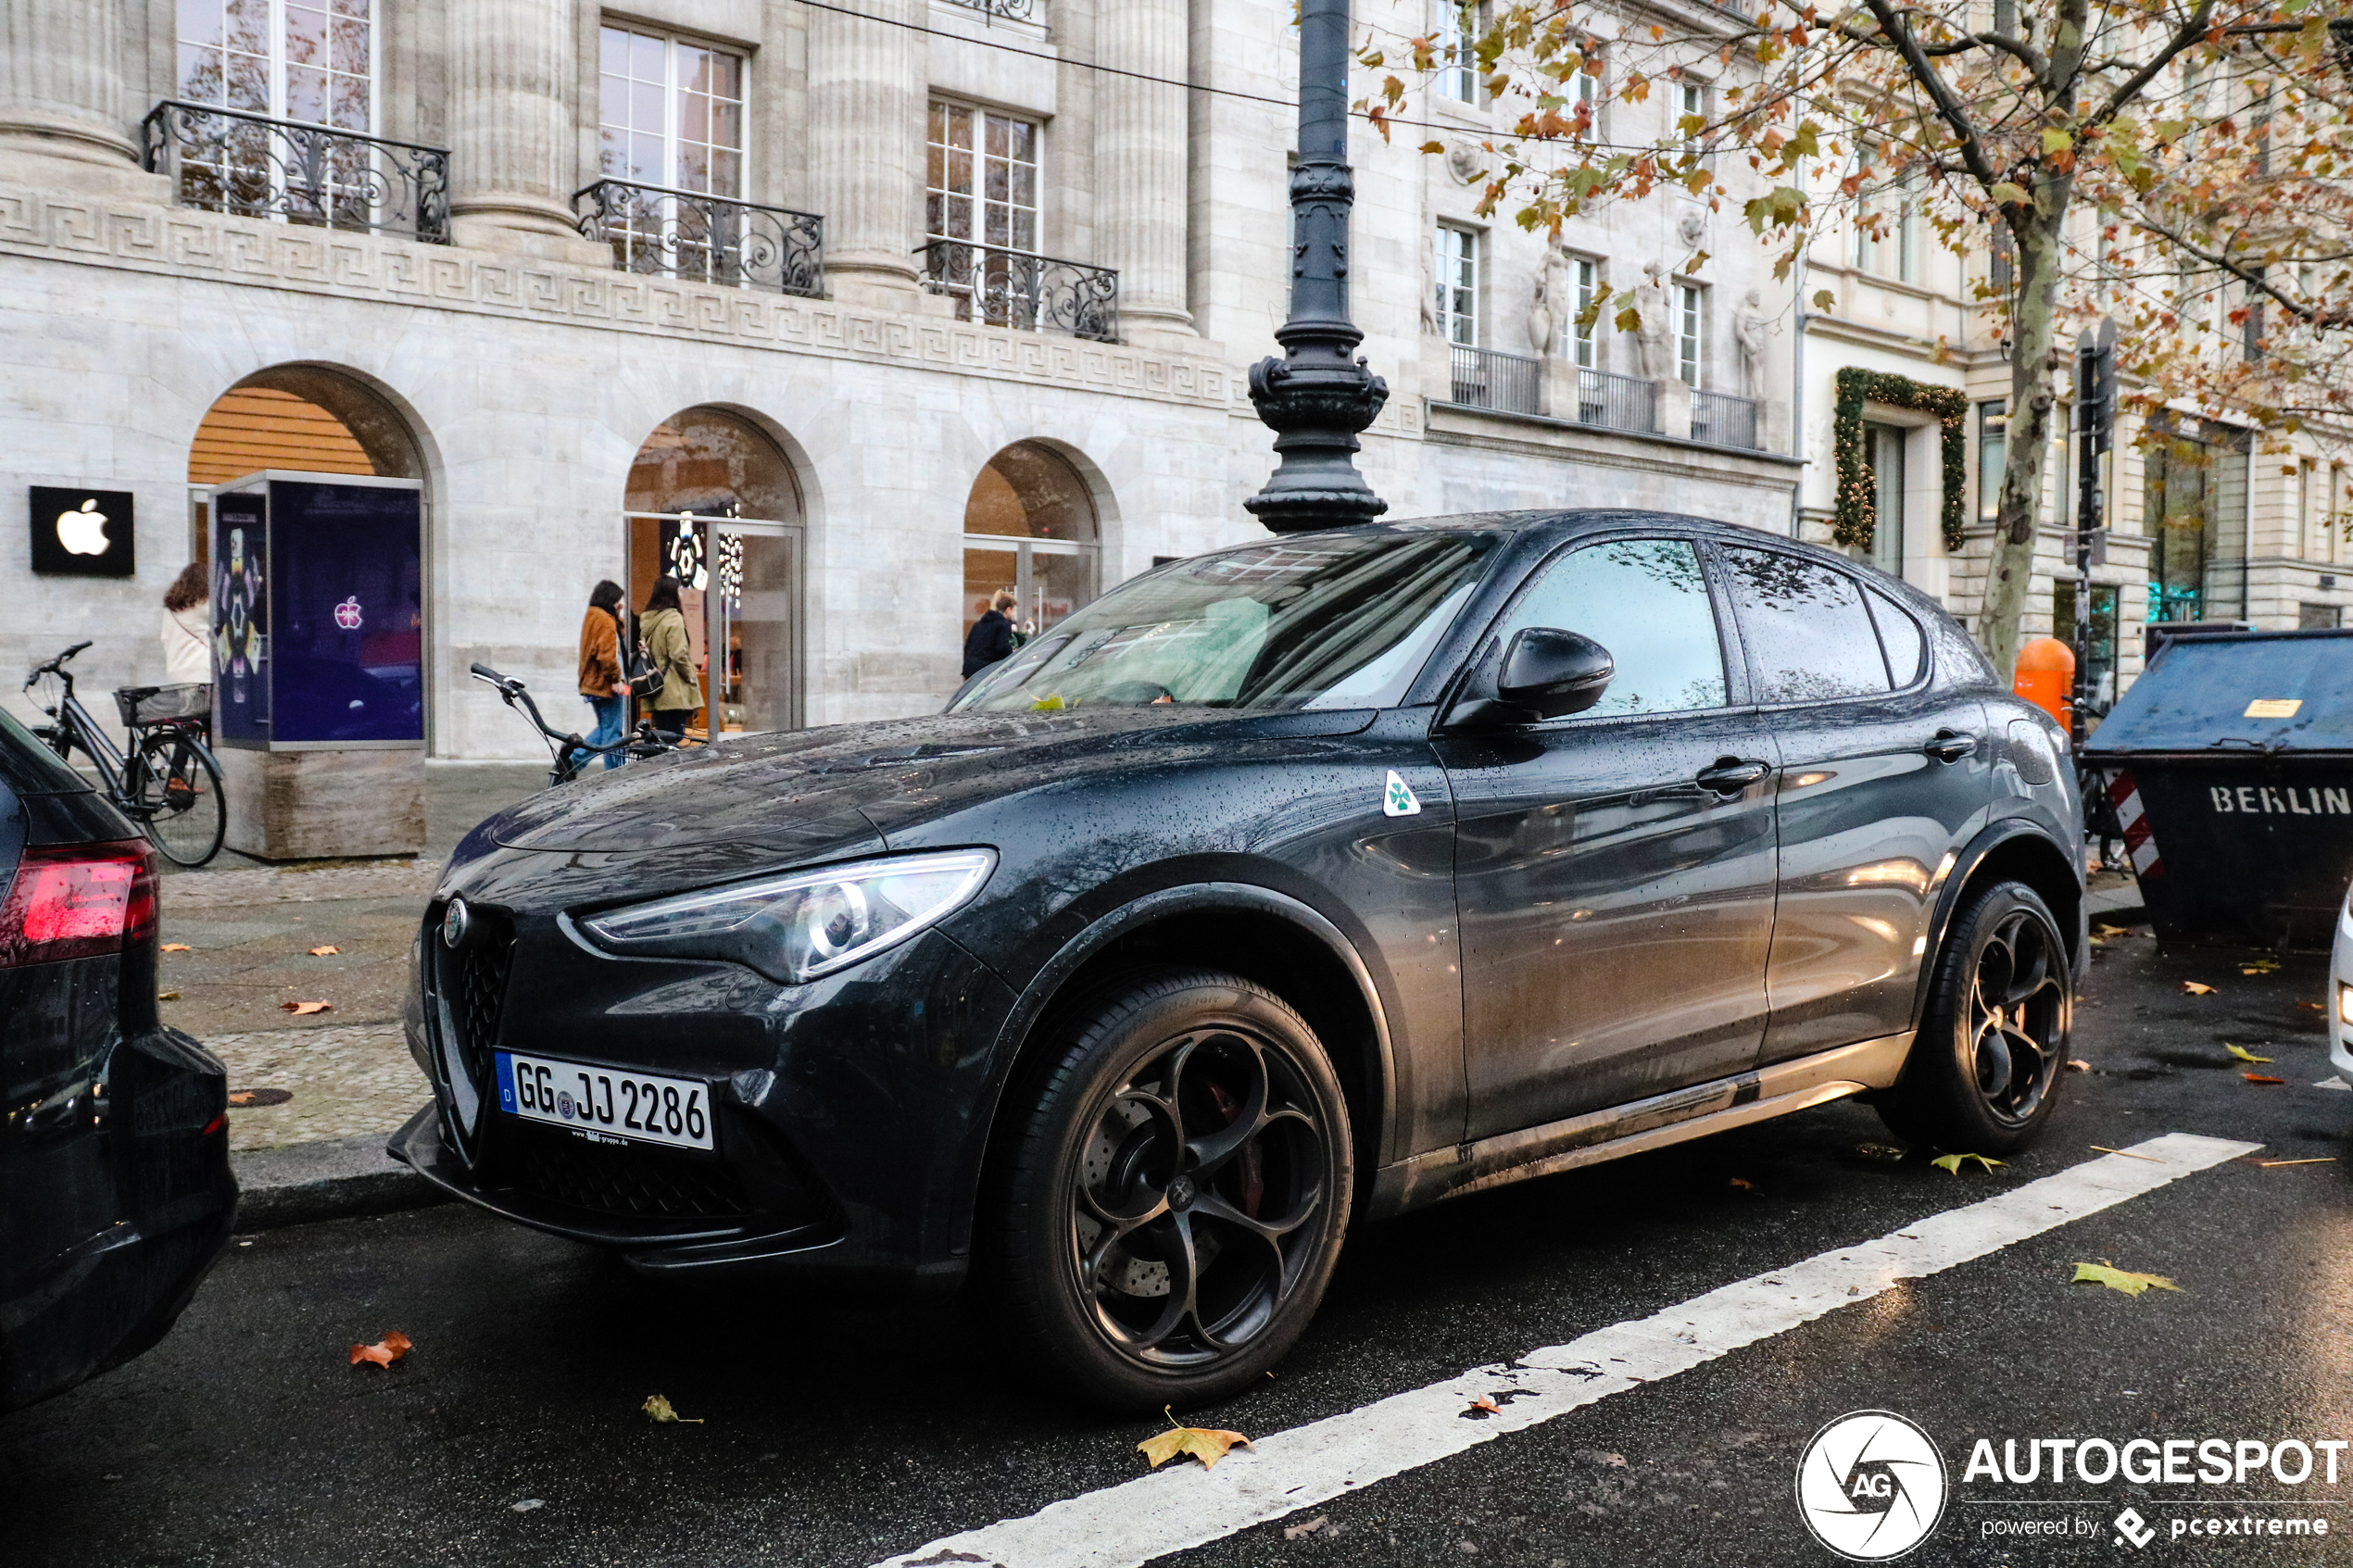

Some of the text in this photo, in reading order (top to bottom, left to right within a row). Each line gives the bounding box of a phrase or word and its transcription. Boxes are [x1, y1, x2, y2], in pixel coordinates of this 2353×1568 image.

[2210, 786, 2351, 815] BERLIN
[504, 1088, 511, 1103] D
[516, 1061, 705, 1139] GG JJ 2286
